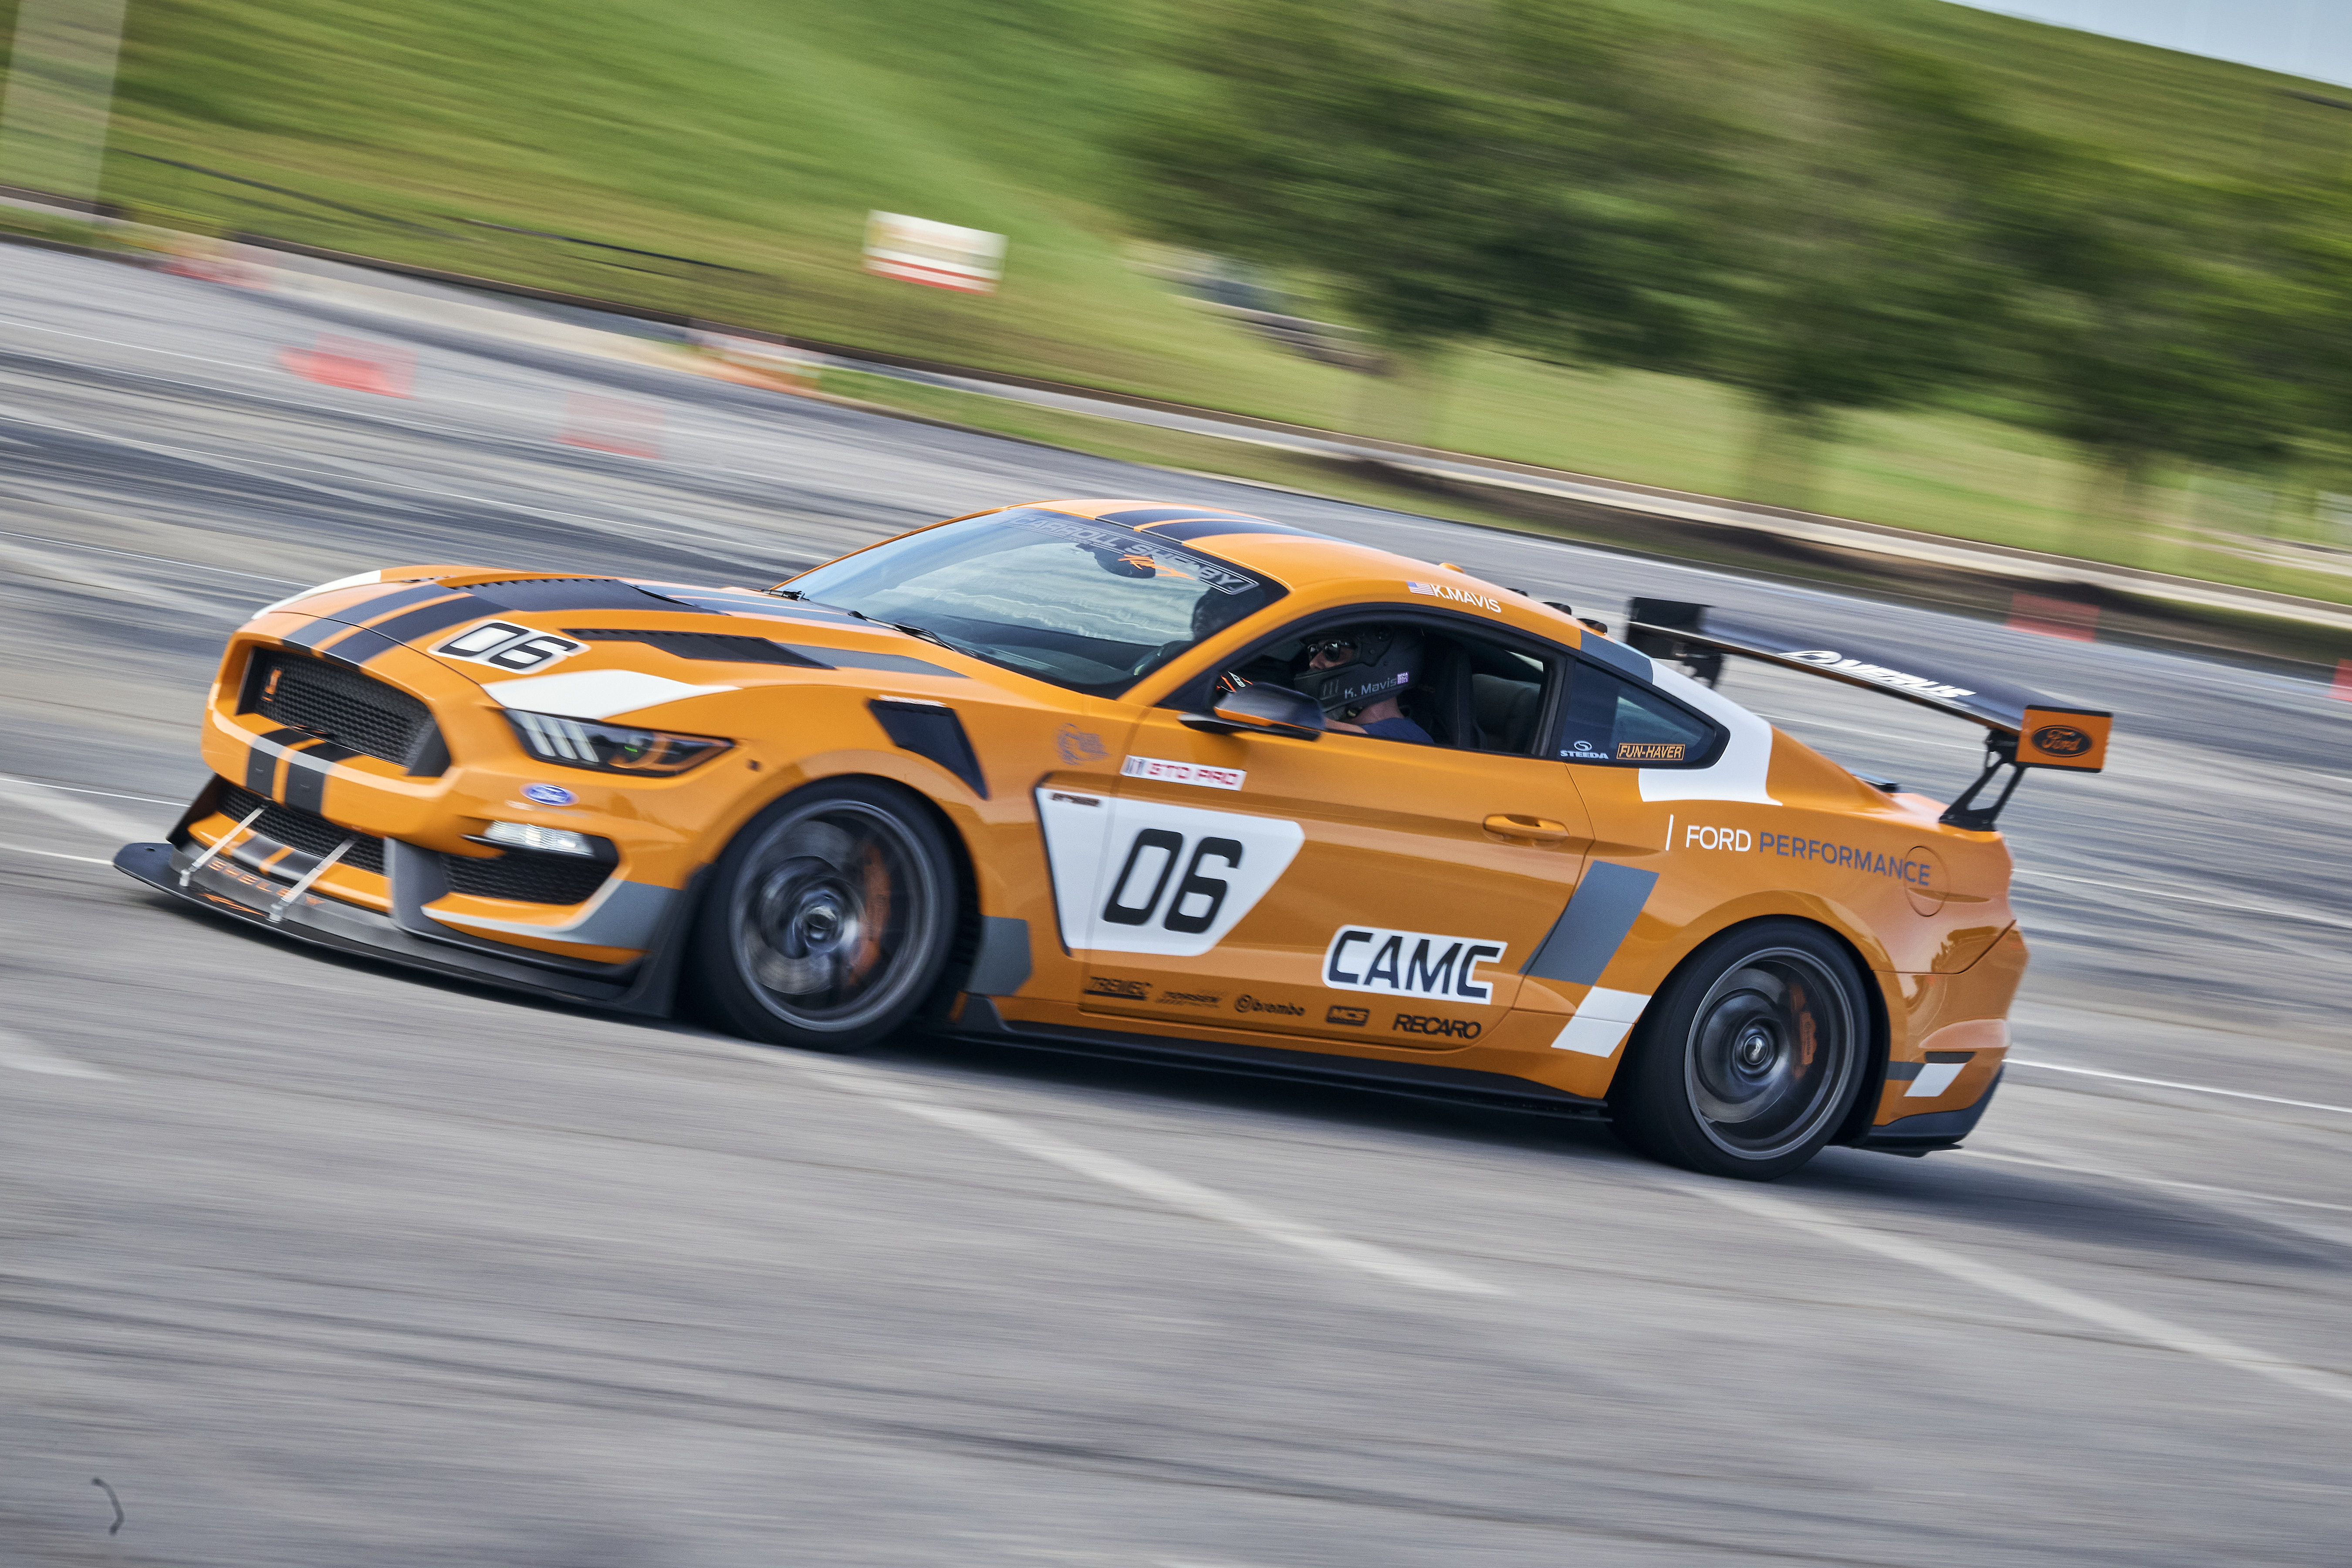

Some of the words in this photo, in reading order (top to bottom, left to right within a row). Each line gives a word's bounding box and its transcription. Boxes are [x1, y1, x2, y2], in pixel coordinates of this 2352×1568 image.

[1015, 516, 1122, 547] CARROLL
[1430, 584, 1501, 613] K.MAVIS
[438, 622, 578, 670] 06
[1361, 677, 1397, 695] Mavis
[1619, 745, 1684, 758] FUN-HAVER
[2041, 729, 2083, 751] Ford
[1560, 750, 1609, 760] STEEDA
[1686, 825, 1751, 852] FORD
[1759, 831, 1931, 886] PERFORMANCE
[1102, 828, 1243, 934] 06
[1328, 930, 1501, 999] CAMC
[1392, 1014, 1482, 1040] RECARO
